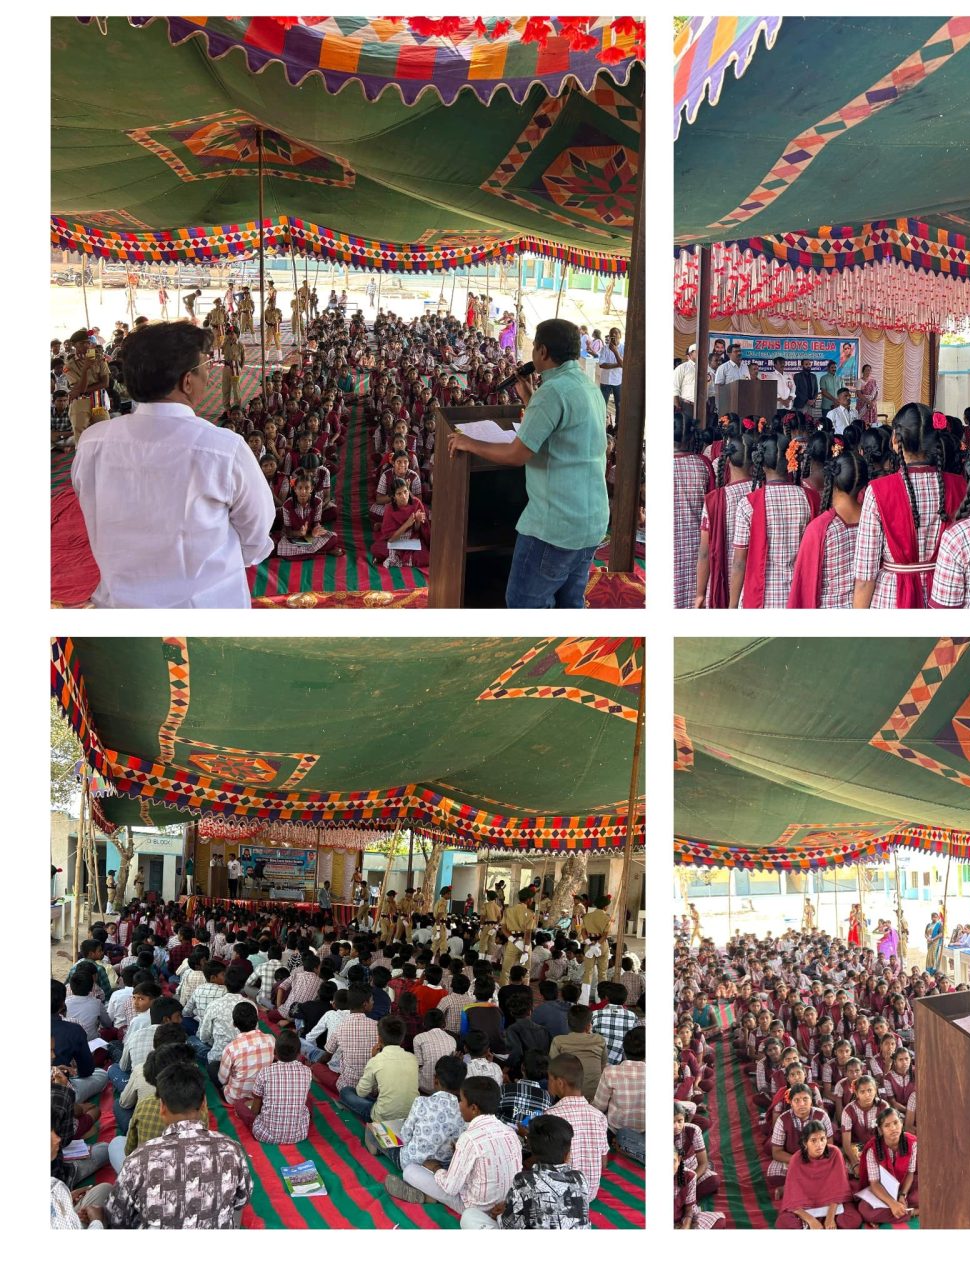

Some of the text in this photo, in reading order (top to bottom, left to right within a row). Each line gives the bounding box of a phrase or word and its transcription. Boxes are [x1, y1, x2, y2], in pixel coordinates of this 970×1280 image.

[755, 340, 781, 351] ZPHS
[783, 341, 808, 351] BOYS
[811, 341, 836, 352] IEEJA
